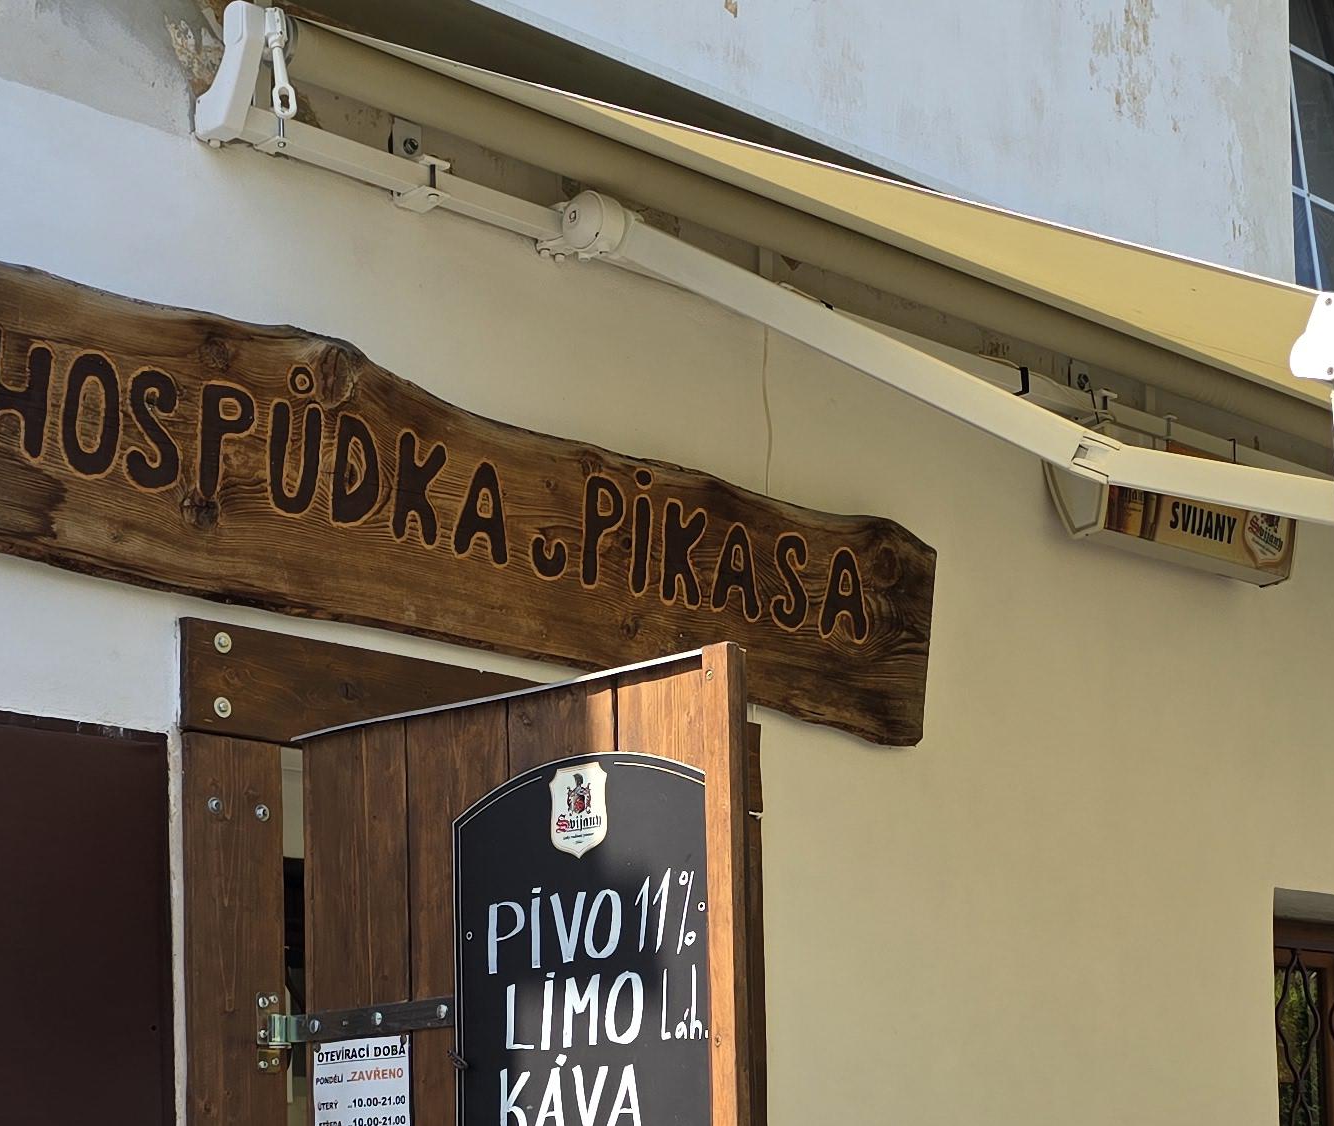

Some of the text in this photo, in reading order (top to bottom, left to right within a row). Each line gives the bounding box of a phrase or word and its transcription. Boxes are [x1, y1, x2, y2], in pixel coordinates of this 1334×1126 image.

[1169, 502, 1237, 544] SVIJANY
[555, 814, 602, 833] Svijany
[317, 1043, 406, 1063] OTEVÍRACÍ DOBA
